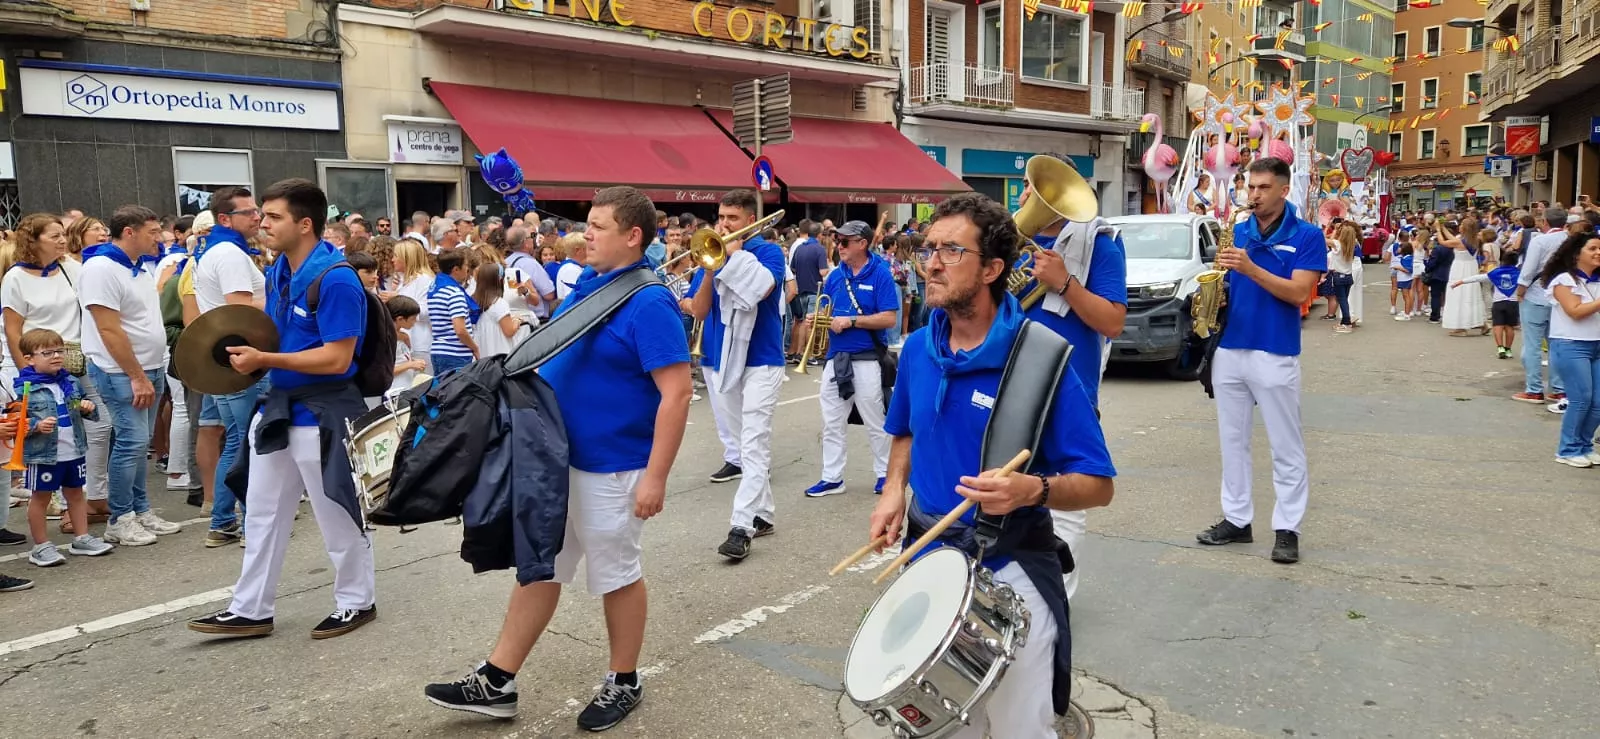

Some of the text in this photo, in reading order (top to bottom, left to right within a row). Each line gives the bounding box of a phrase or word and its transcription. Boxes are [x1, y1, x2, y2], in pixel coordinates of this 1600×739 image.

[693, 2, 870, 58] CORTES
[111, 85, 306, 115] Ortopedia Monros
[411, 143, 432, 151] centro
[444, 145, 459, 153] yoga
